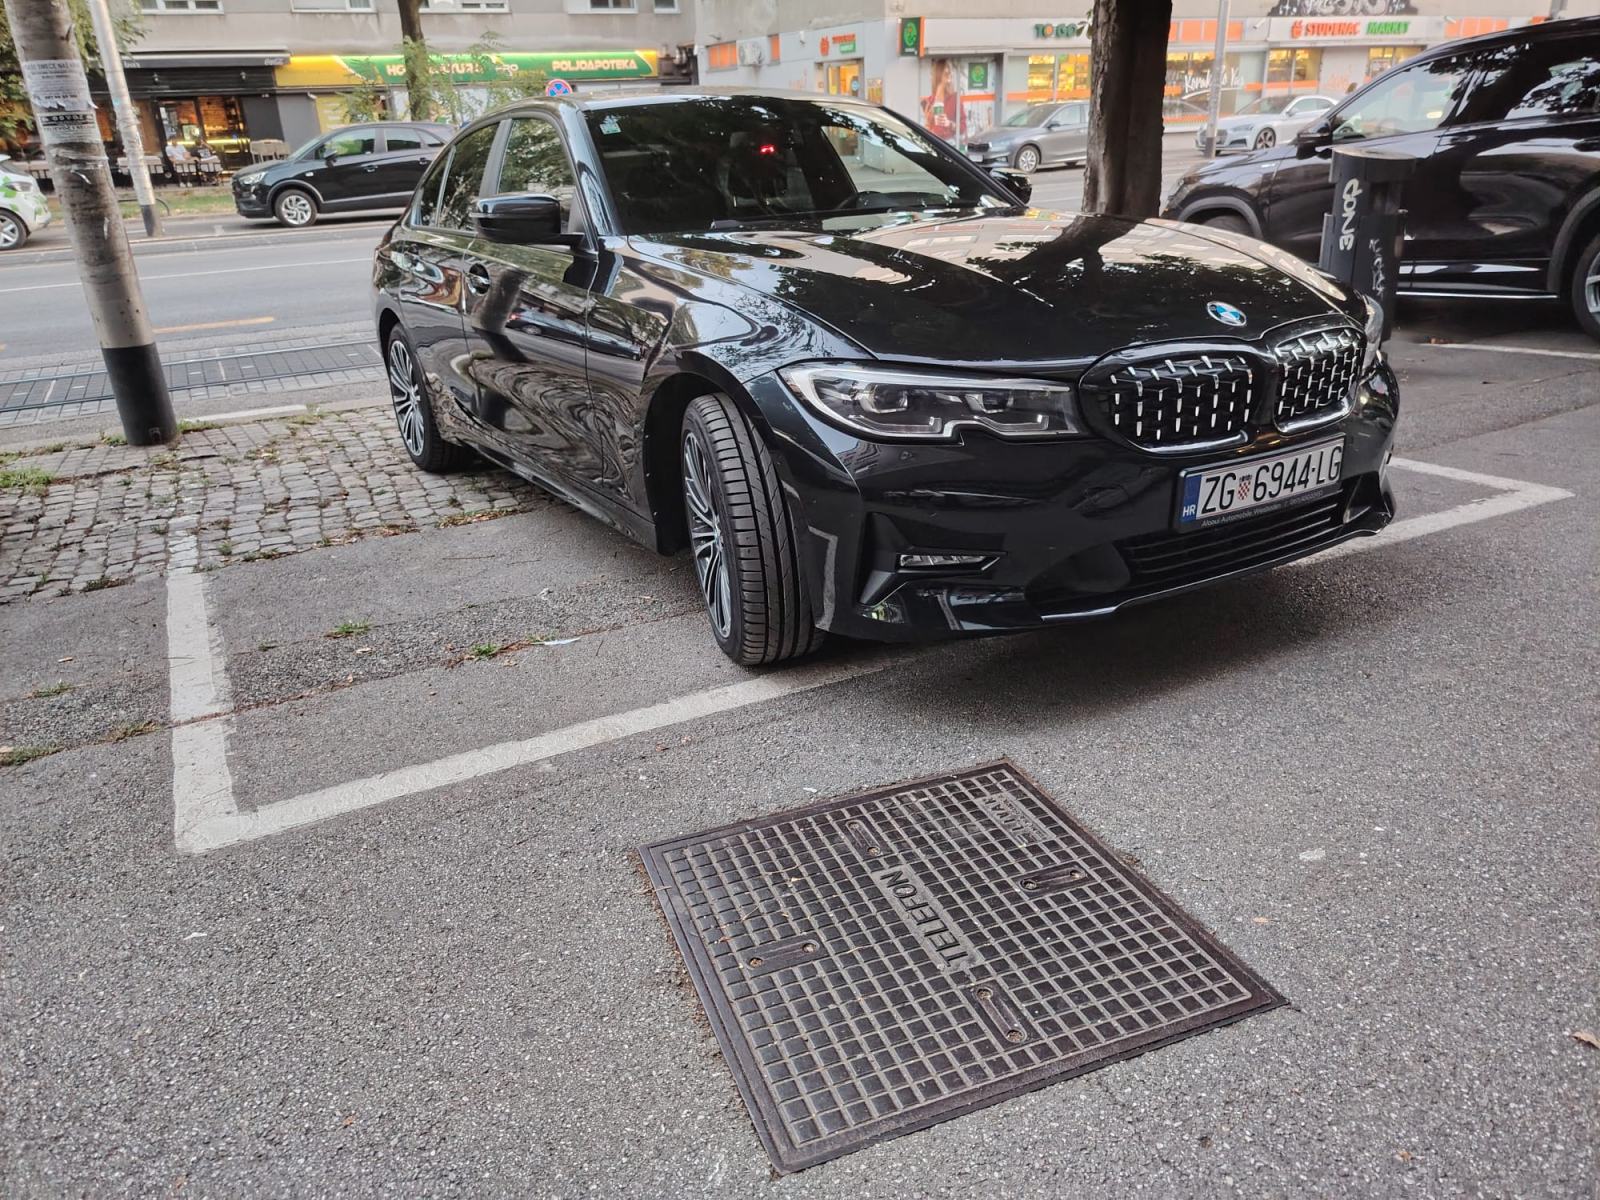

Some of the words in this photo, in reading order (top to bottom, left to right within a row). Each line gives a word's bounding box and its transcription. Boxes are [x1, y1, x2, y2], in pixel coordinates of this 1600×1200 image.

[1034, 23, 1054, 38] TO
[1056, 23, 1077, 38] GO
[1366, 21, 1410, 35] MARKET
[551, 59, 638, 71] POLJOAPOTEKA
[1201, 472, 1237, 514] ZG
[1182, 504, 1197, 518] HR
[880, 870, 968, 968] TELEFON
